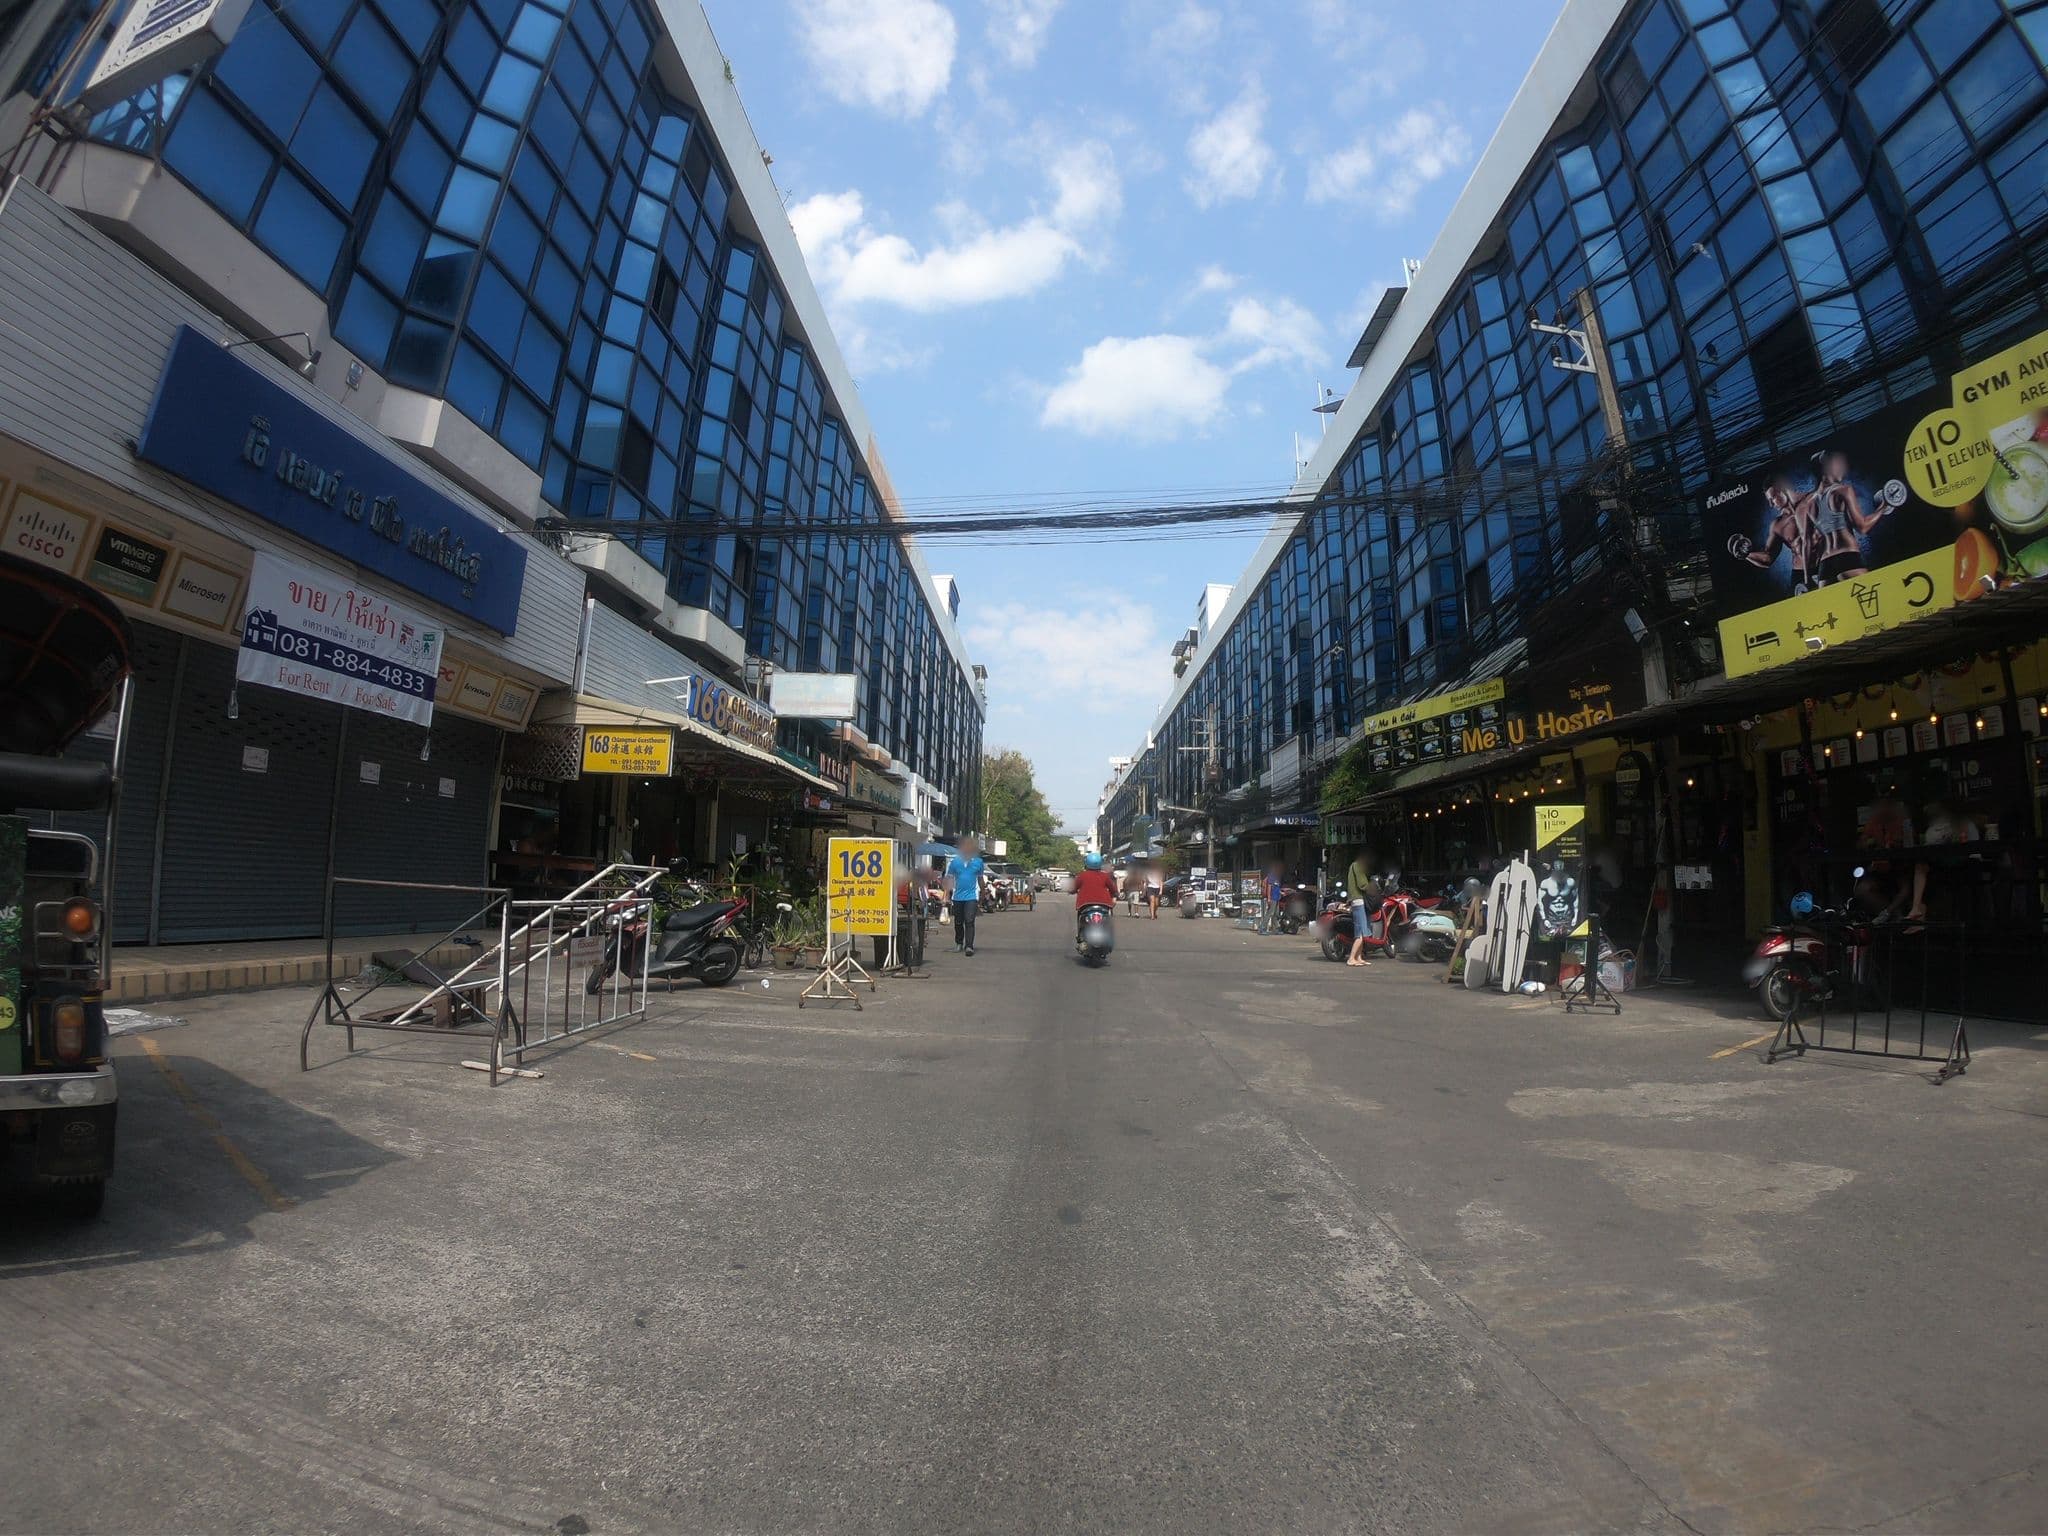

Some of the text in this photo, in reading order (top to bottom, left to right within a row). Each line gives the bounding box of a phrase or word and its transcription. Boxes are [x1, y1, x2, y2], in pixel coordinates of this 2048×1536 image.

[1963, 370, 2011, 403] GYM
[1906, 445, 1928, 463] TEN
[1947, 439, 1991, 468] ELEVEN
[109, 536, 157, 563] vmware
[121, 556, 152, 574] PARTNER
[178, 578, 226, 604] Microsoft
[288, 580, 327, 613] ขาย
[346, 590, 396, 640] ให้เช่า
[1909, 608, 1935, 620] REPEAT
[1864, 620, 1886, 634] DRINK
[280, 633, 425, 693] 081-884-4833
[1758, 653, 1772, 664] BED
[278, 665, 302, 687] For
[303, 673, 331, 695] Rent
[355, 687, 374, 705] For
[374, 693, 398, 712] Sale
[464, 682, 491, 698] lenovo
[1450, 690, 1477, 702] Breakfast
[1482, 683, 1500, 696] Lunch
[688, 675, 728, 729] 168
[1378, 718, 1389, 730] Me
[1462, 701, 1615, 754] Me U Hostel
[589, 734, 610, 754] 168
[1275, 817, 1287, 825] Me
[839, 850, 883, 878] 168
